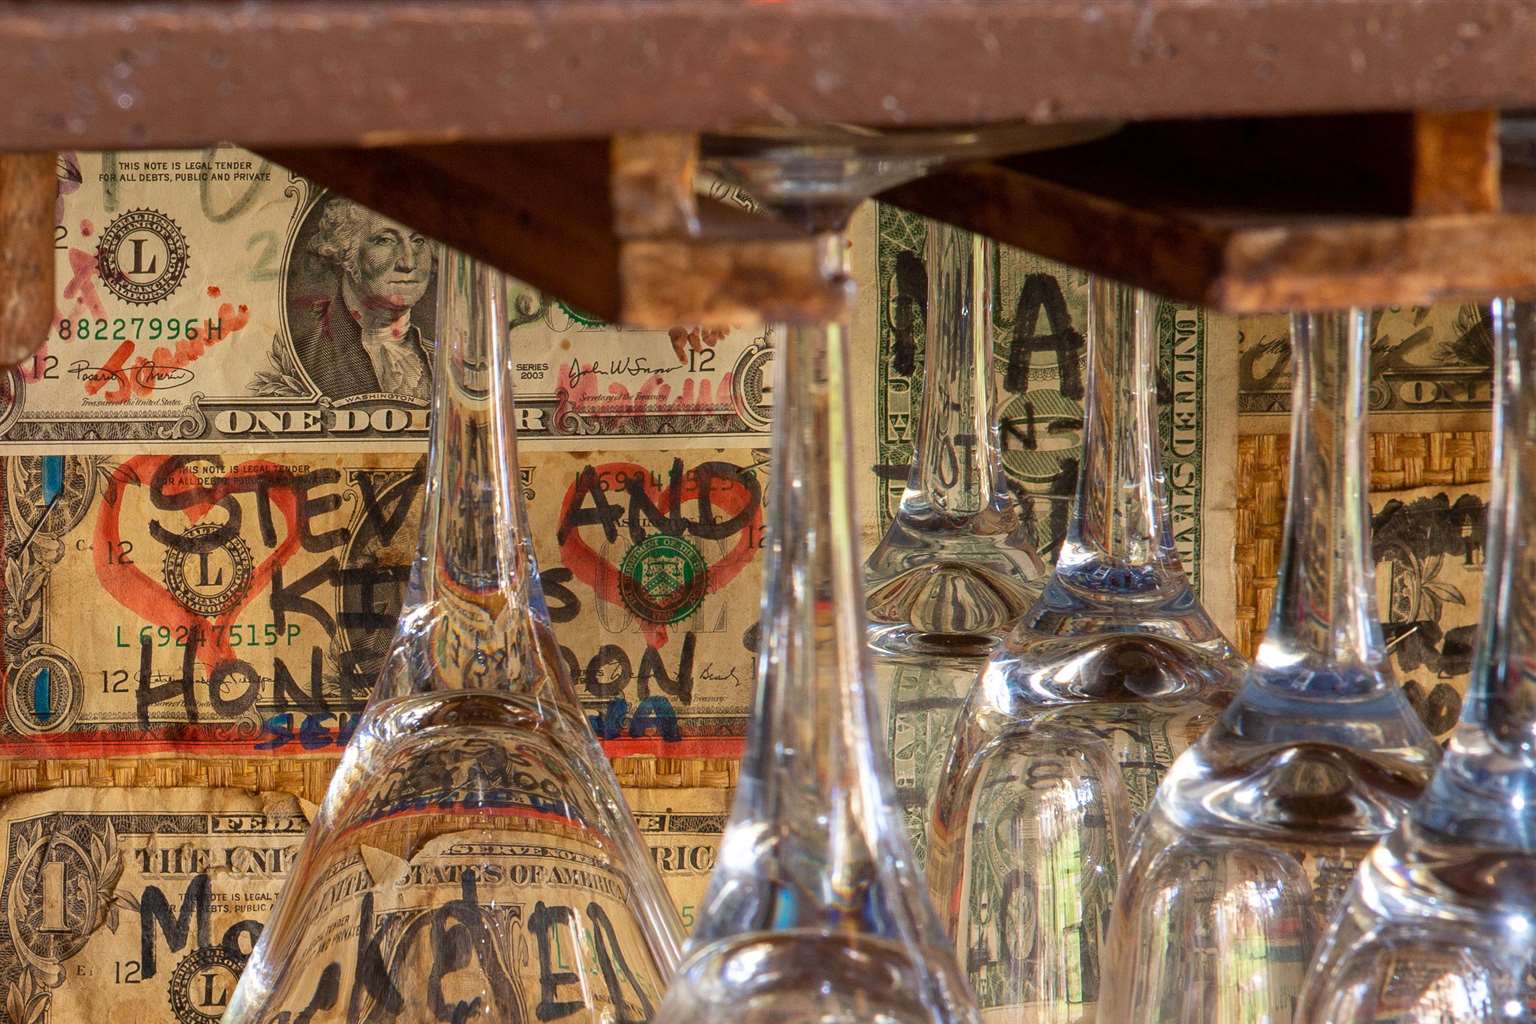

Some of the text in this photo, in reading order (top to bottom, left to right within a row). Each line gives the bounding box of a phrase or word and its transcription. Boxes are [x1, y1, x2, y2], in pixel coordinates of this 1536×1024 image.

[98, 172, 272, 183] FOR ALL DEBTS, PUBLIC AND PRIVATE
[118, 161, 253, 170] THIS NOTE IS LEGAL TENDER
[127, 238, 157, 274] L
[57, 317, 222, 341] 88227996H
[32, 355, 59, 380] 12
[515, 363, 549, 372] SERIES
[687, 348, 716, 373] 12
[520, 372, 545, 380] 2003
[214, 407, 323, 434] ONE
[556, 456, 762, 546] AND
[106, 541, 135, 565] 12
[195, 551, 224, 588] L
[101, 669, 130, 693] 12
[114, 960, 141, 985] 12
[199, 972, 227, 1007] L
